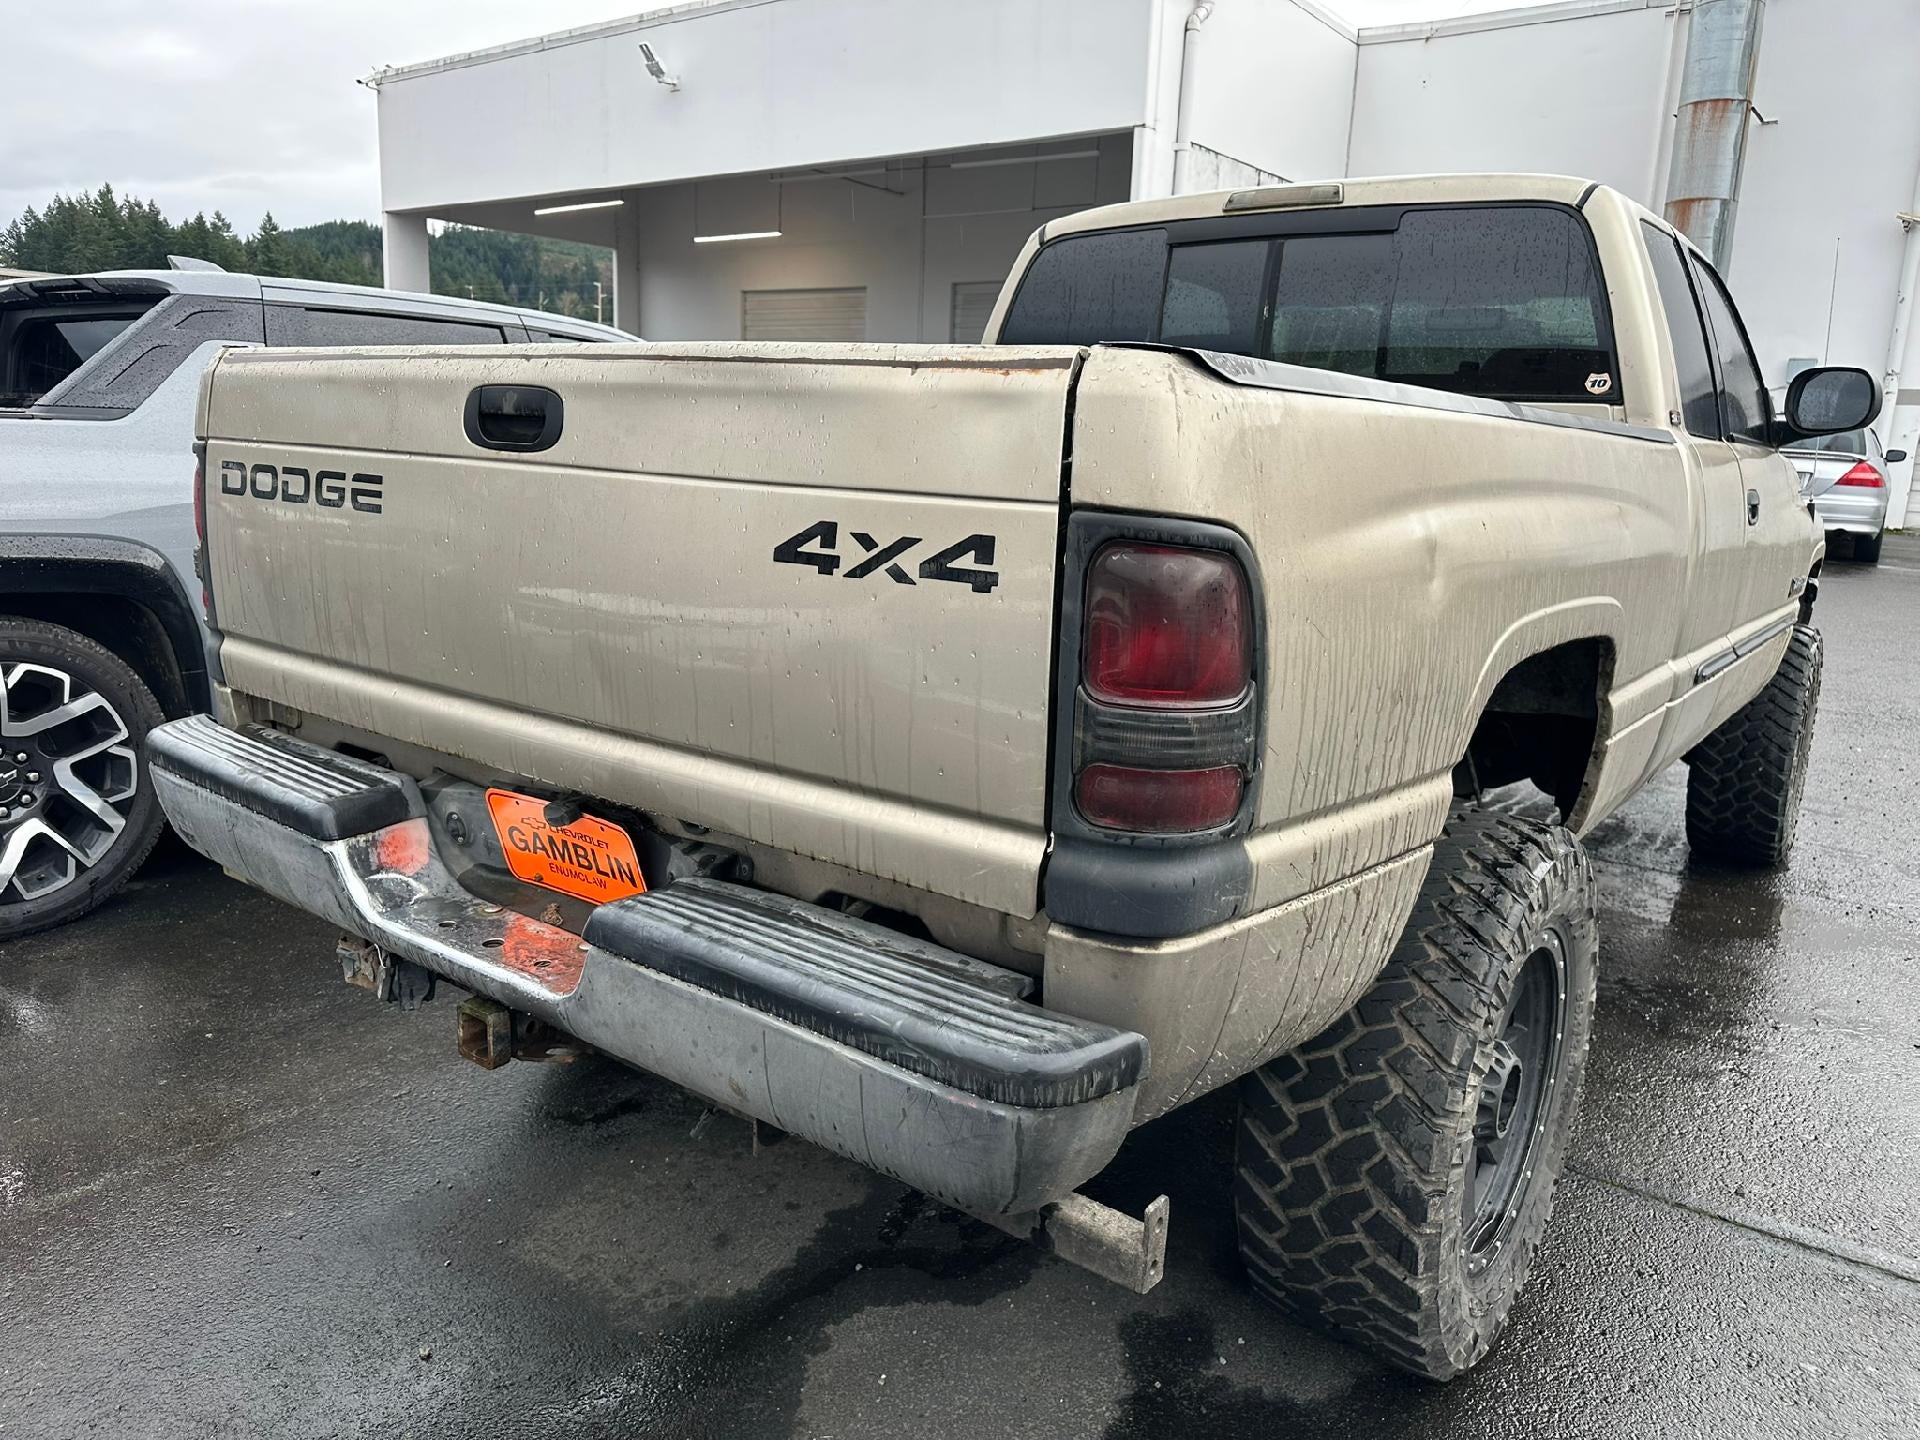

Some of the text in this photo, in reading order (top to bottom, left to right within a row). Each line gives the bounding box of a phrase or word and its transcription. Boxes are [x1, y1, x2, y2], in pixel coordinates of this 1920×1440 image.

[221, 460, 383, 514] DODGE
[507, 825, 638, 888] GAMBLIN
[550, 826, 609, 849] CHEVROLET
[549, 863, 607, 889] ENUMCLAW
